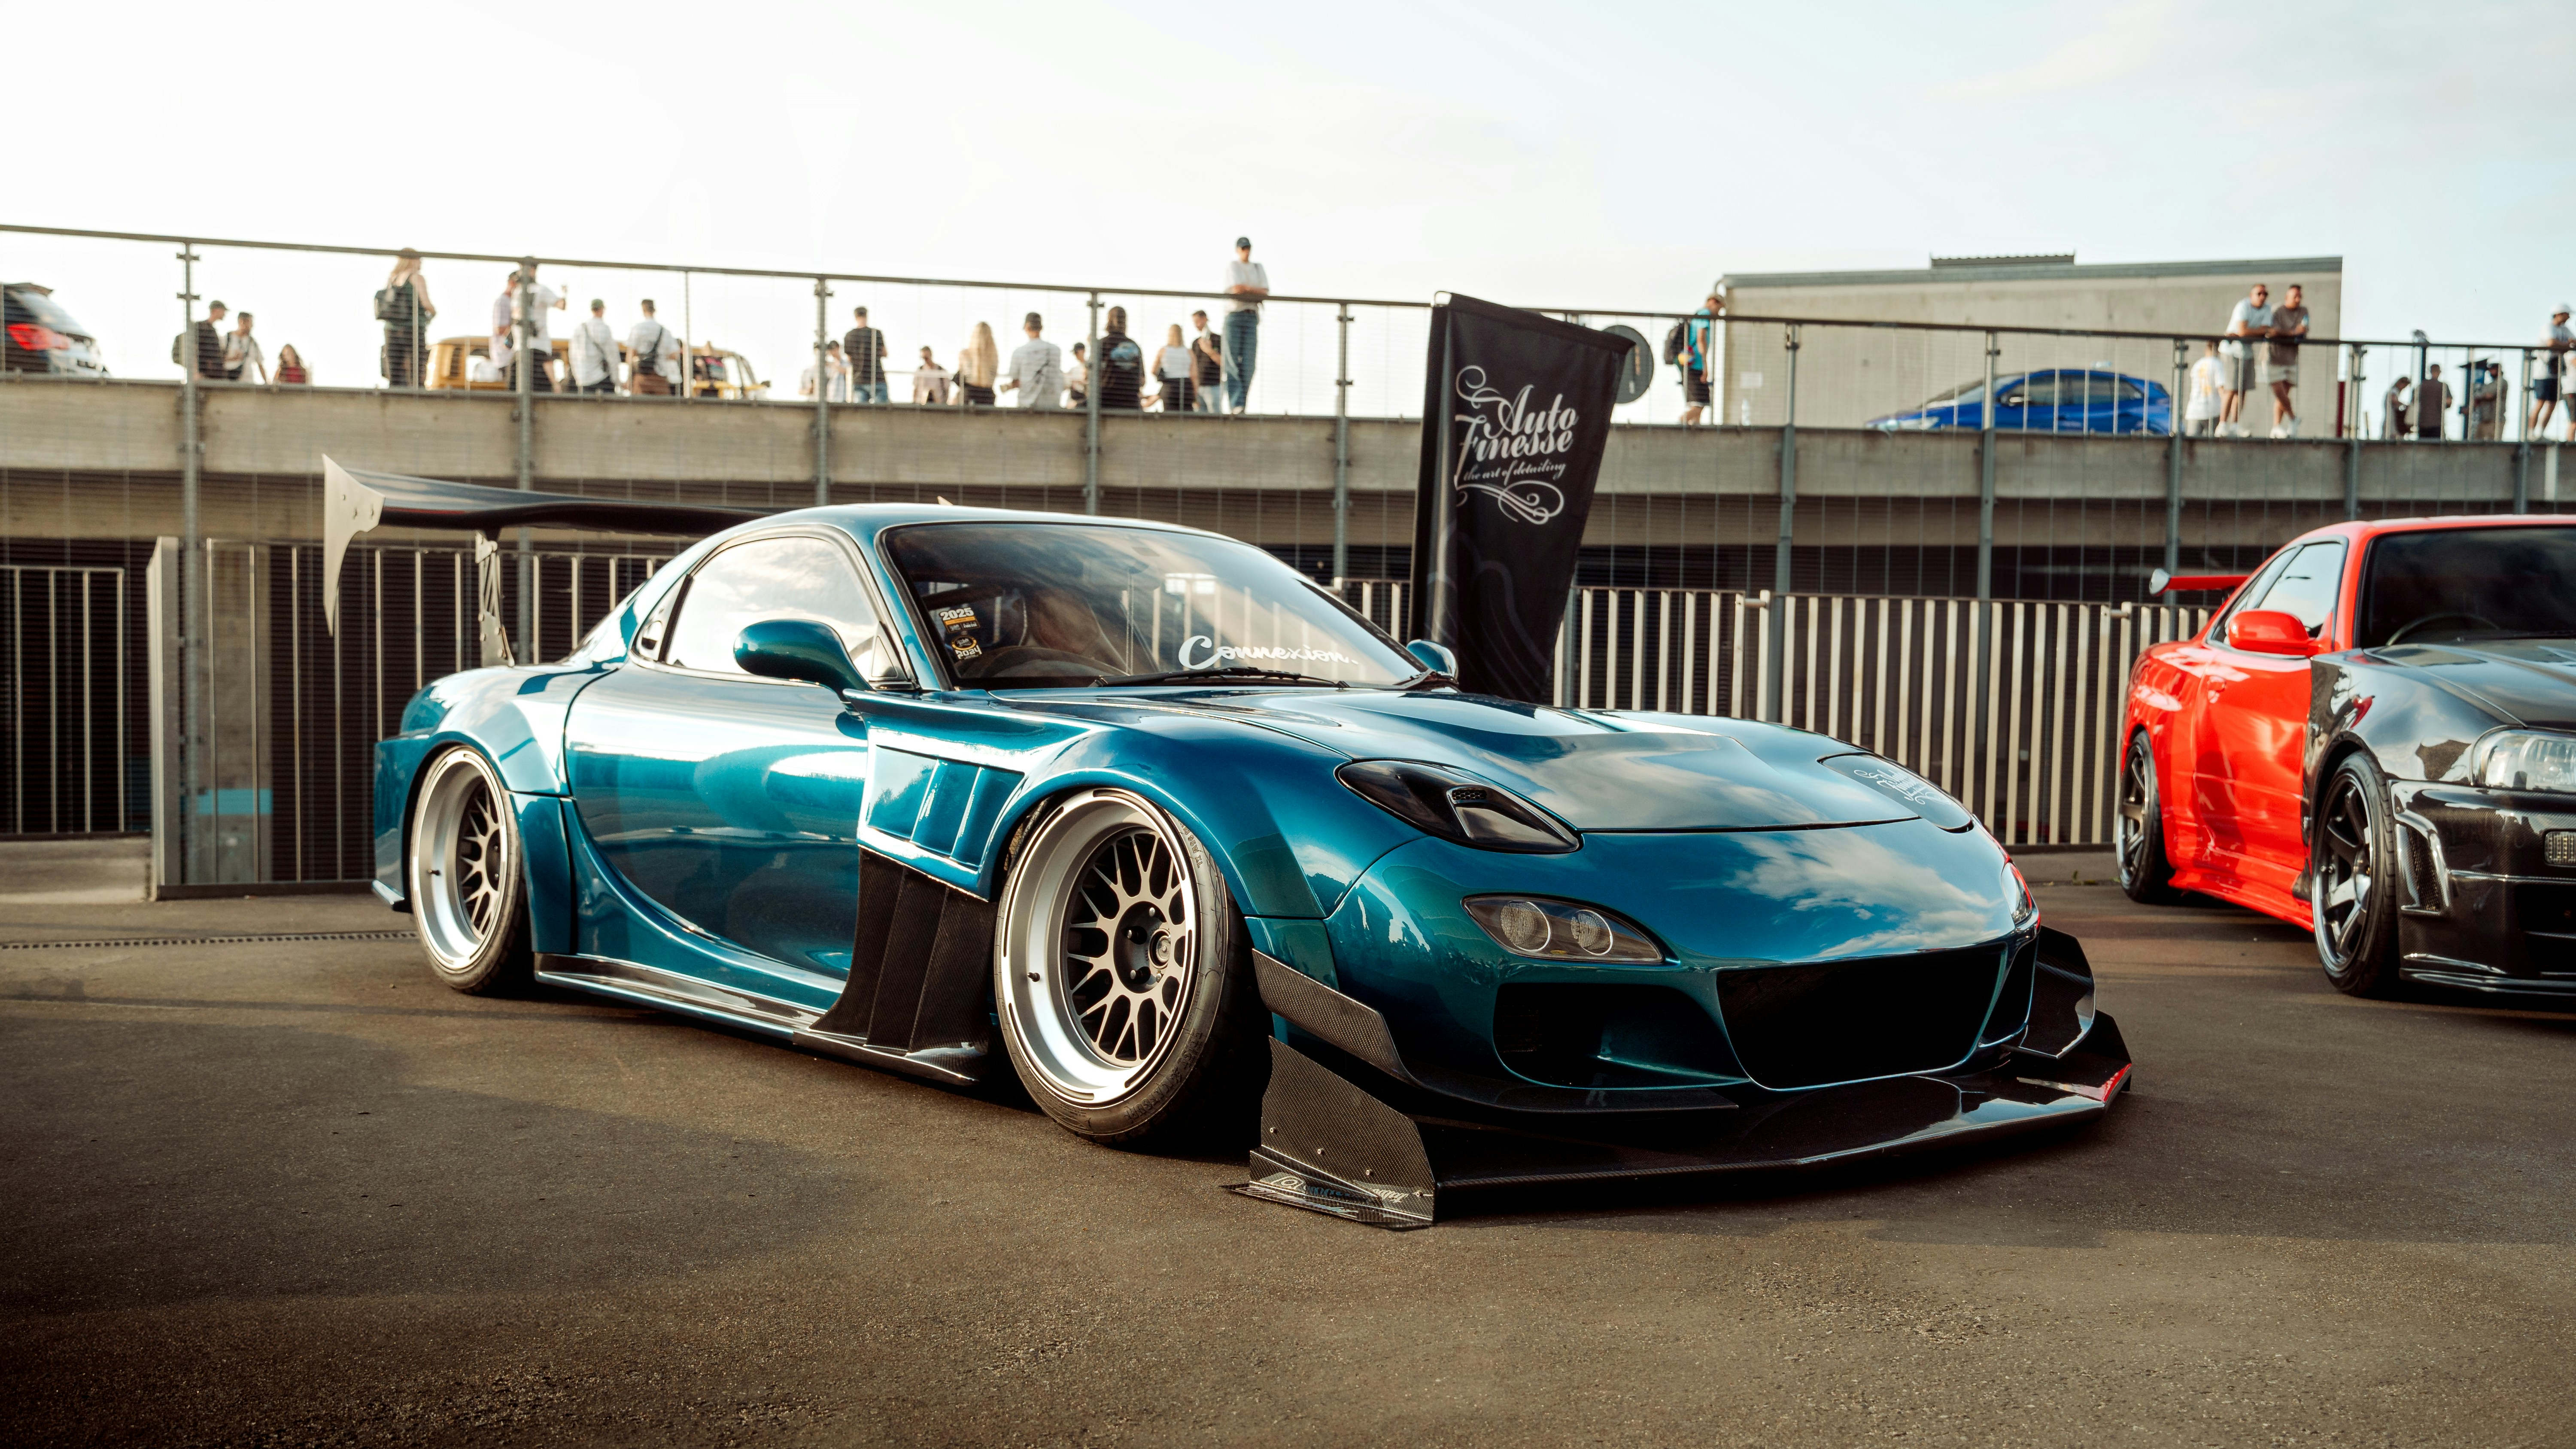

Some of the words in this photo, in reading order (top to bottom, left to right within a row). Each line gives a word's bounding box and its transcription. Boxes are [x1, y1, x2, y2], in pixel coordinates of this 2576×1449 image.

[1484, 384, 1579, 439] Auto
[1454, 414, 1574, 476] Finesse
[1464, 463, 1481, 481] the
[1482, 467, 1501, 479] art
[1501, 459, 1518, 486] of
[1513, 458, 1566, 480] detailing
[940, 608, 974, 621] 2025
[955, 644, 982, 659] 2024
[1188, 835, 1199, 854] 95W
[1195, 855, 1203, 869] XL
